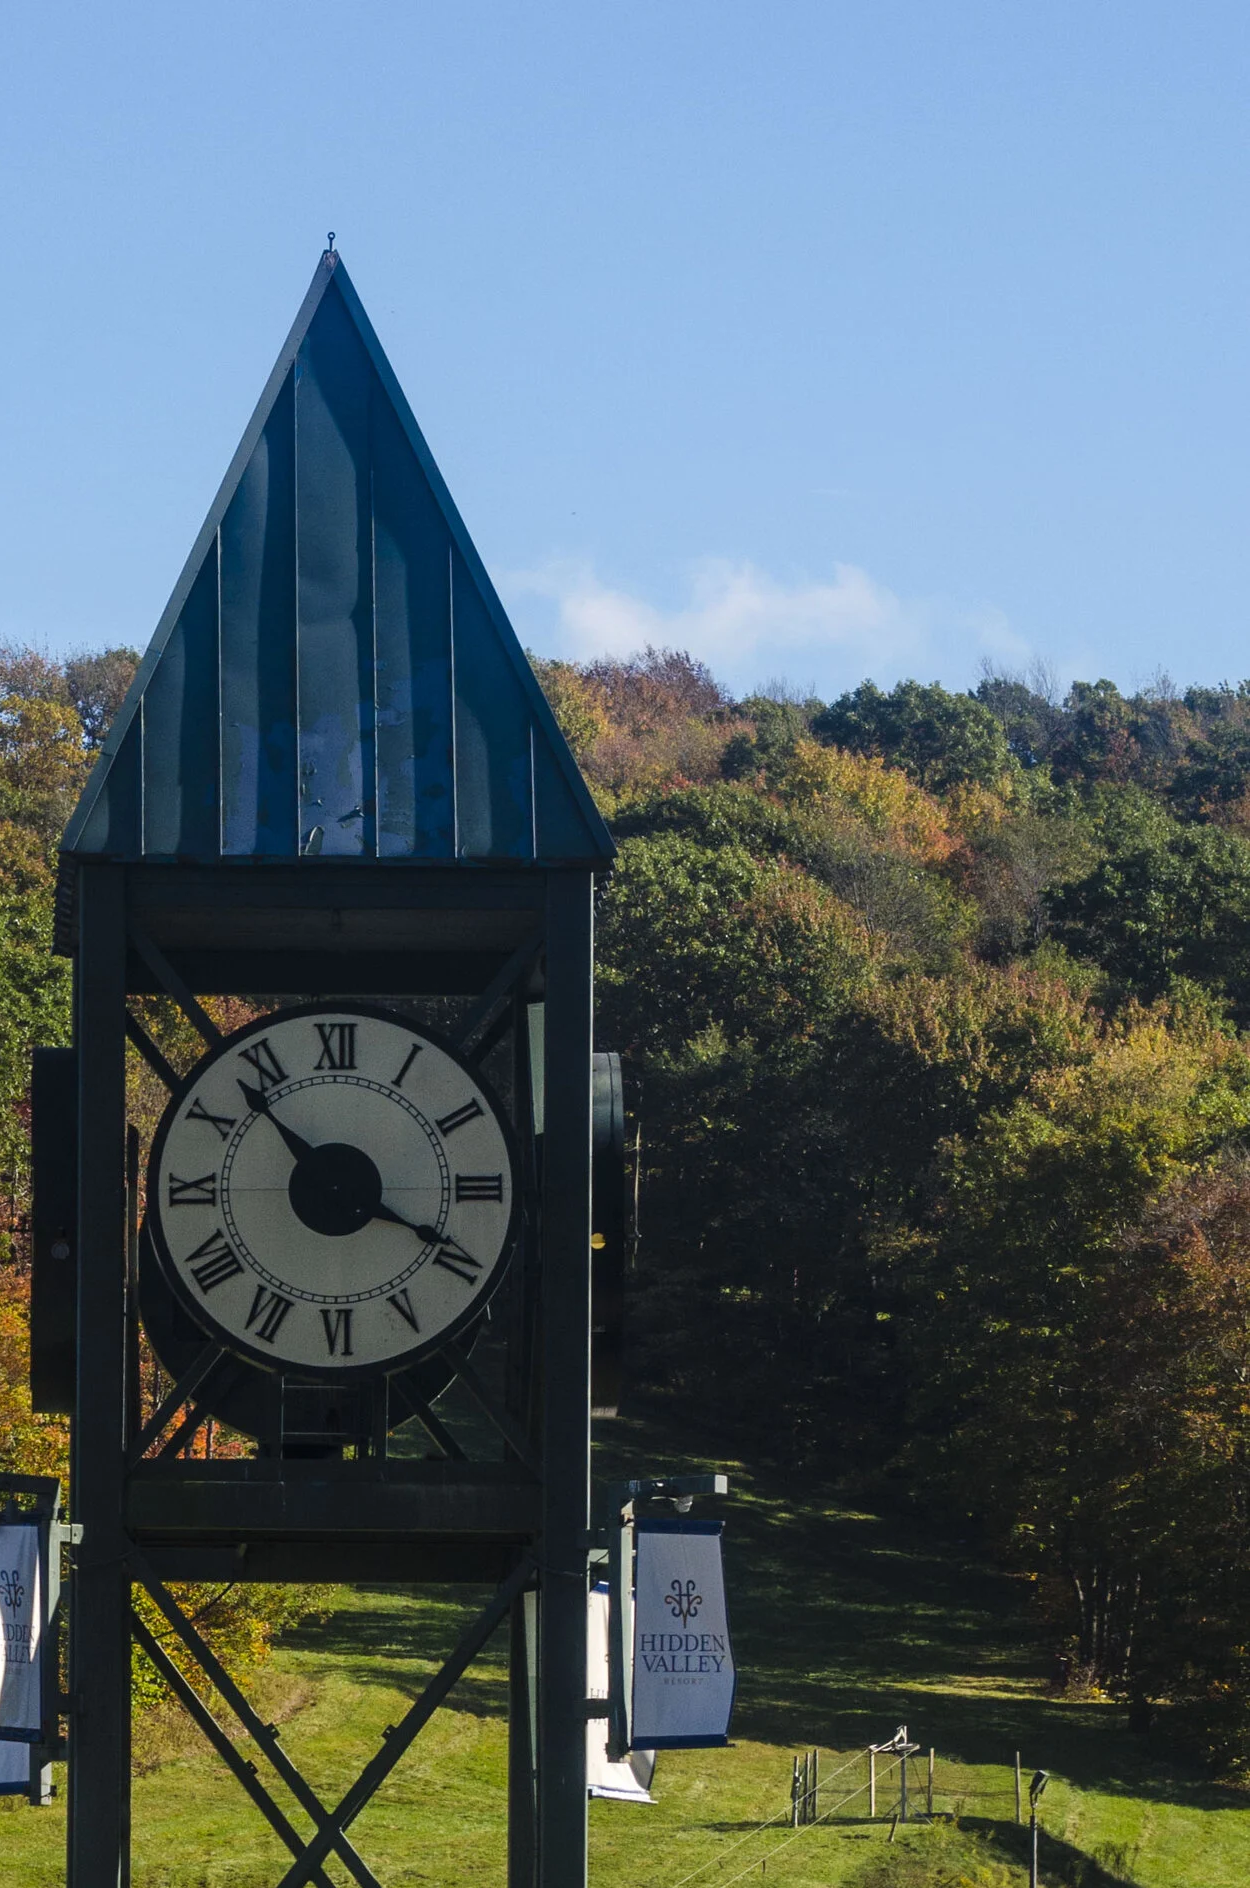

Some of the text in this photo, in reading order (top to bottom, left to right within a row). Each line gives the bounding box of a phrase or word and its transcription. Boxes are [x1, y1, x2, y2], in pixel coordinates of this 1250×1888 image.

[238, 1038, 290, 1093] XI
[313, 1023, 358, 1070] XII
[391, 1044, 423, 1088] I
[185, 1097, 238, 1142] X
[435, 1097, 486, 1138] II
[168, 1172, 216, 1207] IX
[455, 1173, 503, 1204] III
[184, 1228, 245, 1295] VIII
[432, 1235, 484, 1286] IV
[244, 1284, 294, 1344] VII
[319, 1308, 353, 1356] VI
[386, 1287, 420, 1334] V
[640, 1633, 725, 1652] HIDDEN
[642, 1655, 726, 1673] VALLEY
